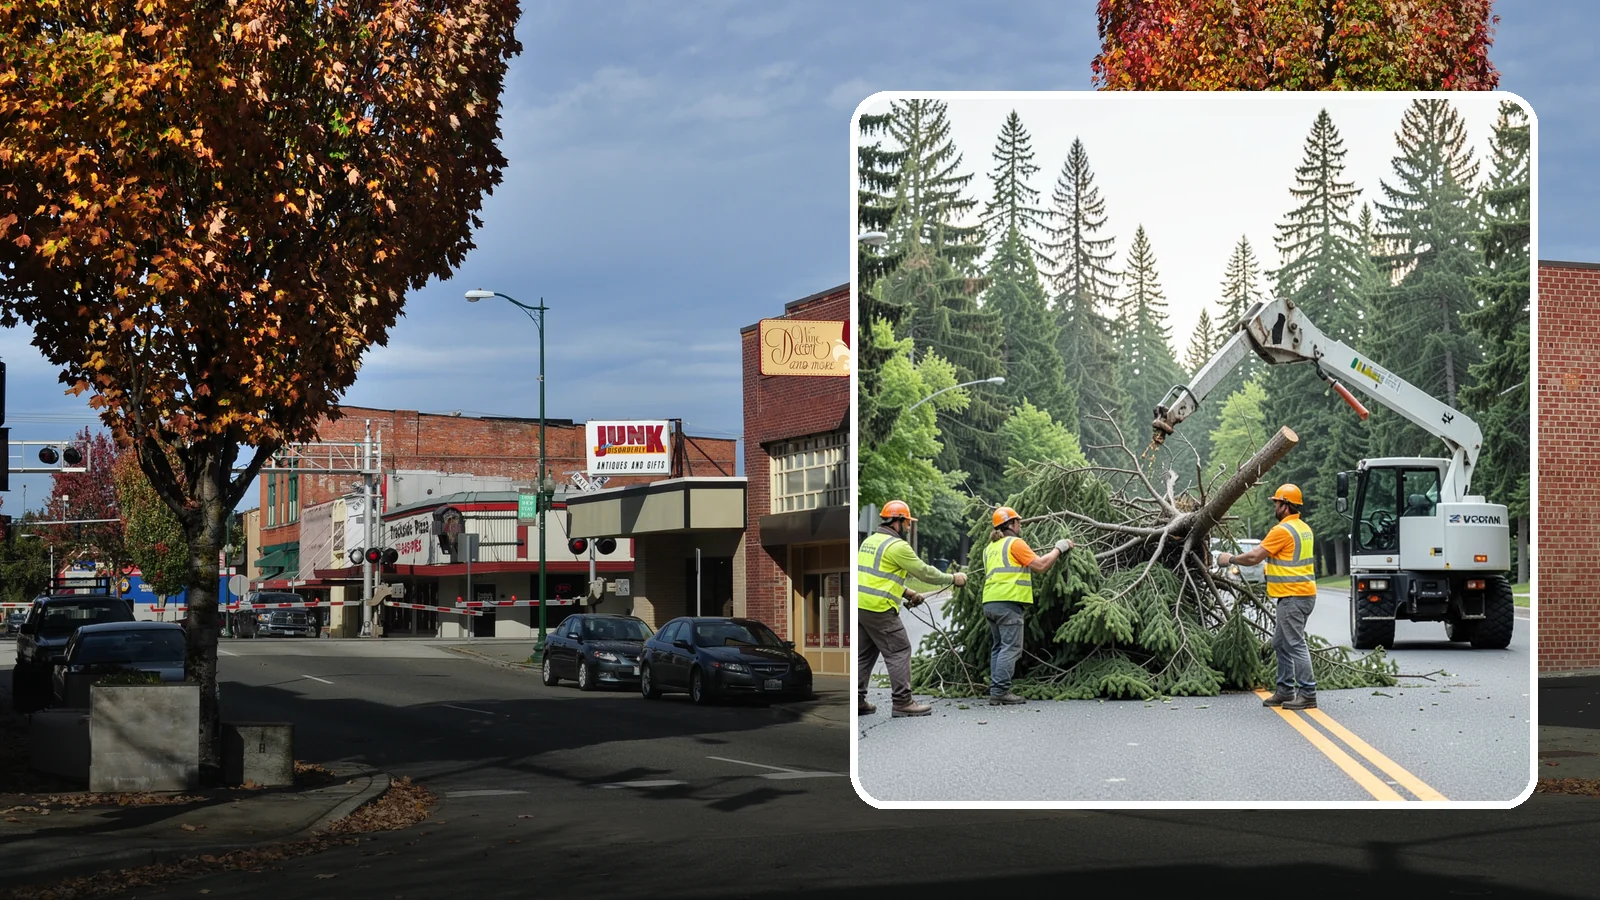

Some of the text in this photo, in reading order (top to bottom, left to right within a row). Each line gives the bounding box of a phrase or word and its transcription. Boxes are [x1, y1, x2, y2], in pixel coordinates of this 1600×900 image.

[595, 425, 665, 457] JUNK
[607, 446, 646, 454] DISORDERLY
[596, 460, 665, 470] ANTIQUES AND GIFTS
[414, 519, 429, 535] Pizza
